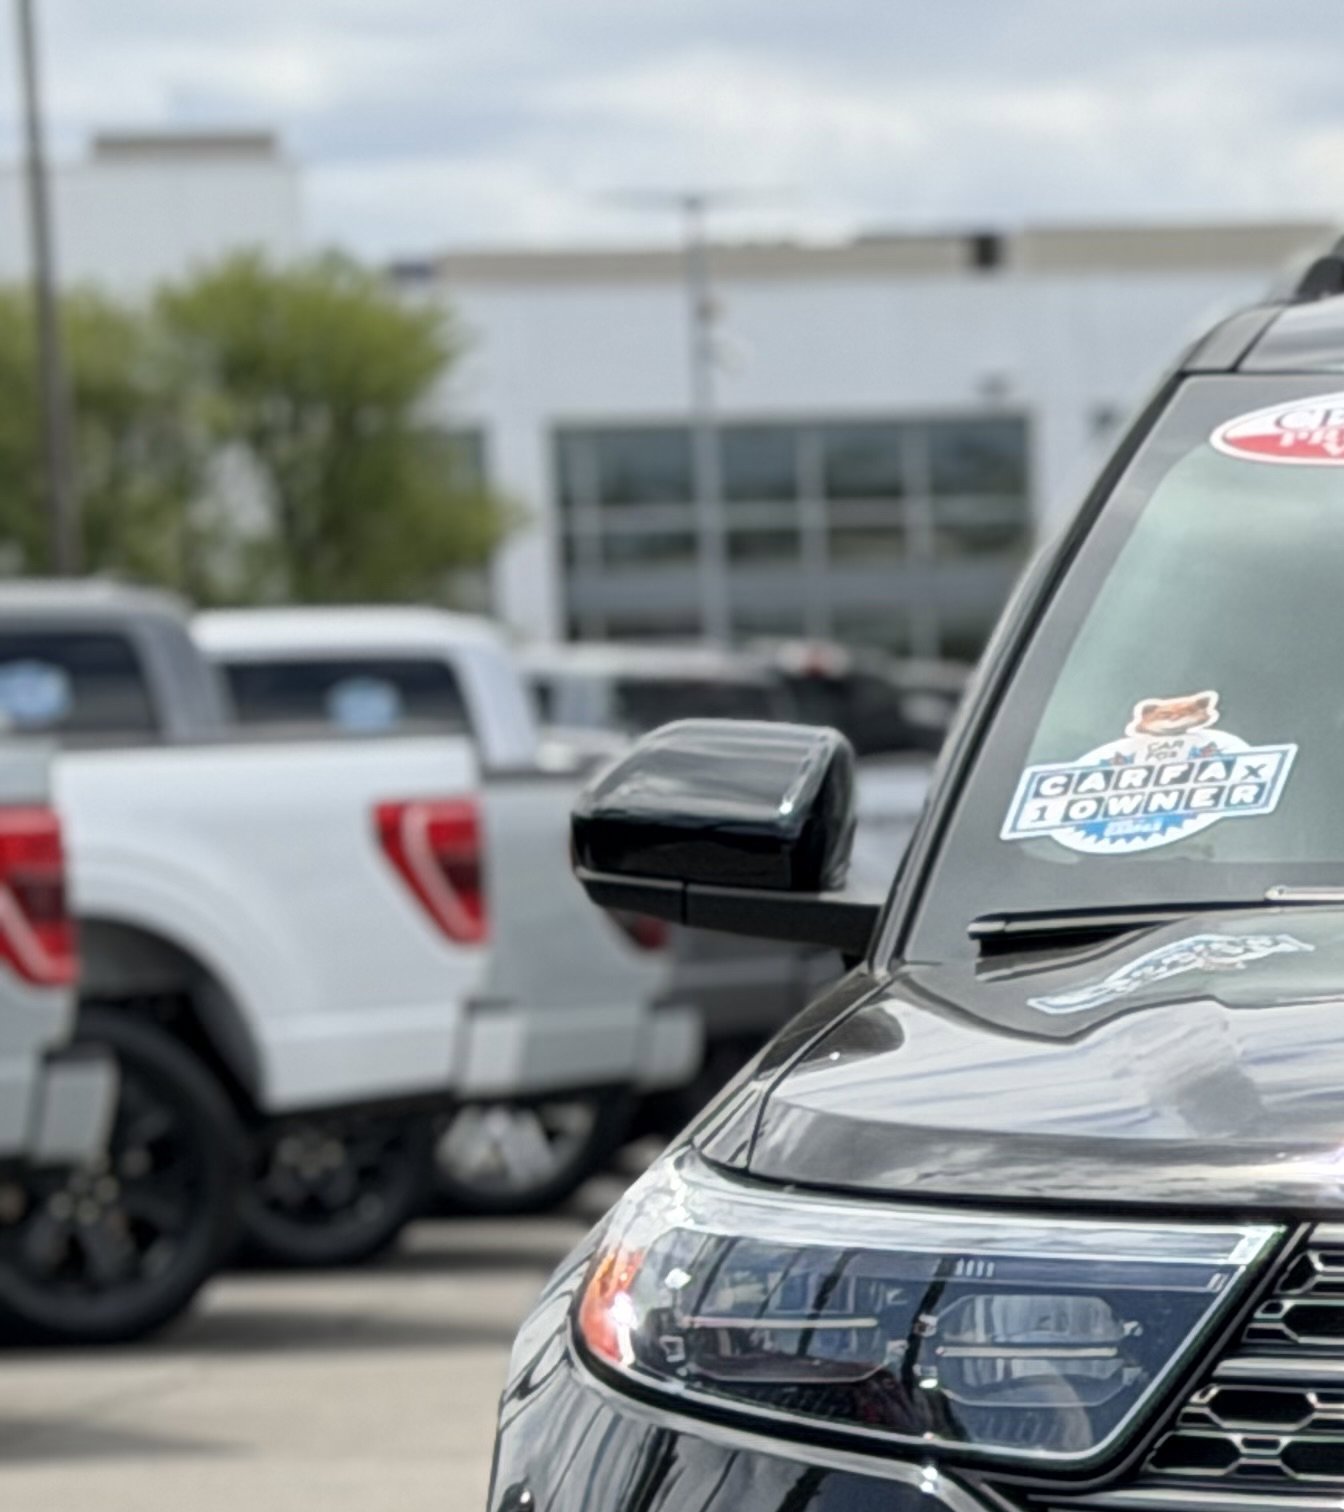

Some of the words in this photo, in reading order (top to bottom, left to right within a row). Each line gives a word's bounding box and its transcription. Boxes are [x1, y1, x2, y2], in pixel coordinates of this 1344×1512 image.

[1037, 761, 1268, 797] CARFAX
[1030, 805, 1050, 823] 1
[1067, 783, 1258, 819] OWNER
